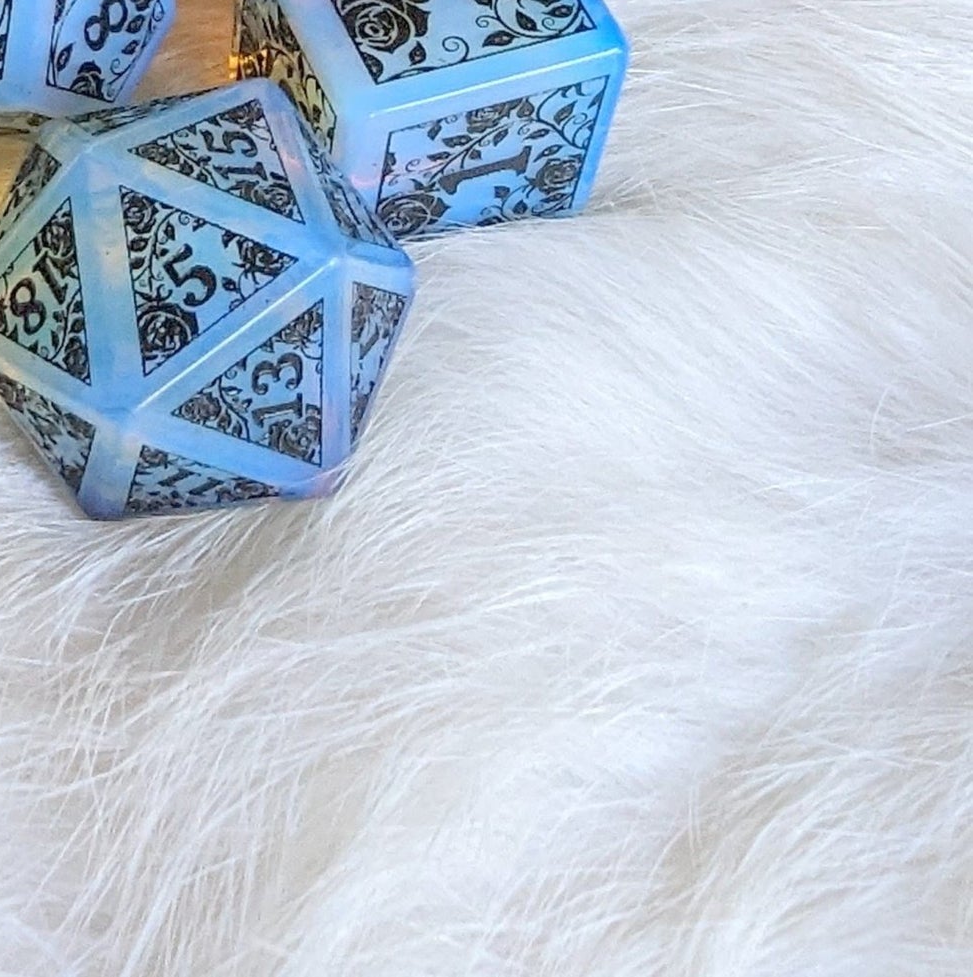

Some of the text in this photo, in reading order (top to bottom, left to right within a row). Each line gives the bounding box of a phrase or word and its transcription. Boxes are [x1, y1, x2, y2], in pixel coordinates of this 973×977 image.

[202, 130, 267, 181] 15
[438, 145, 531, 195] 1
[10, 249, 75, 334] 18
[163, 243, 217, 307] 5
[251, 352, 303, 424] 13
